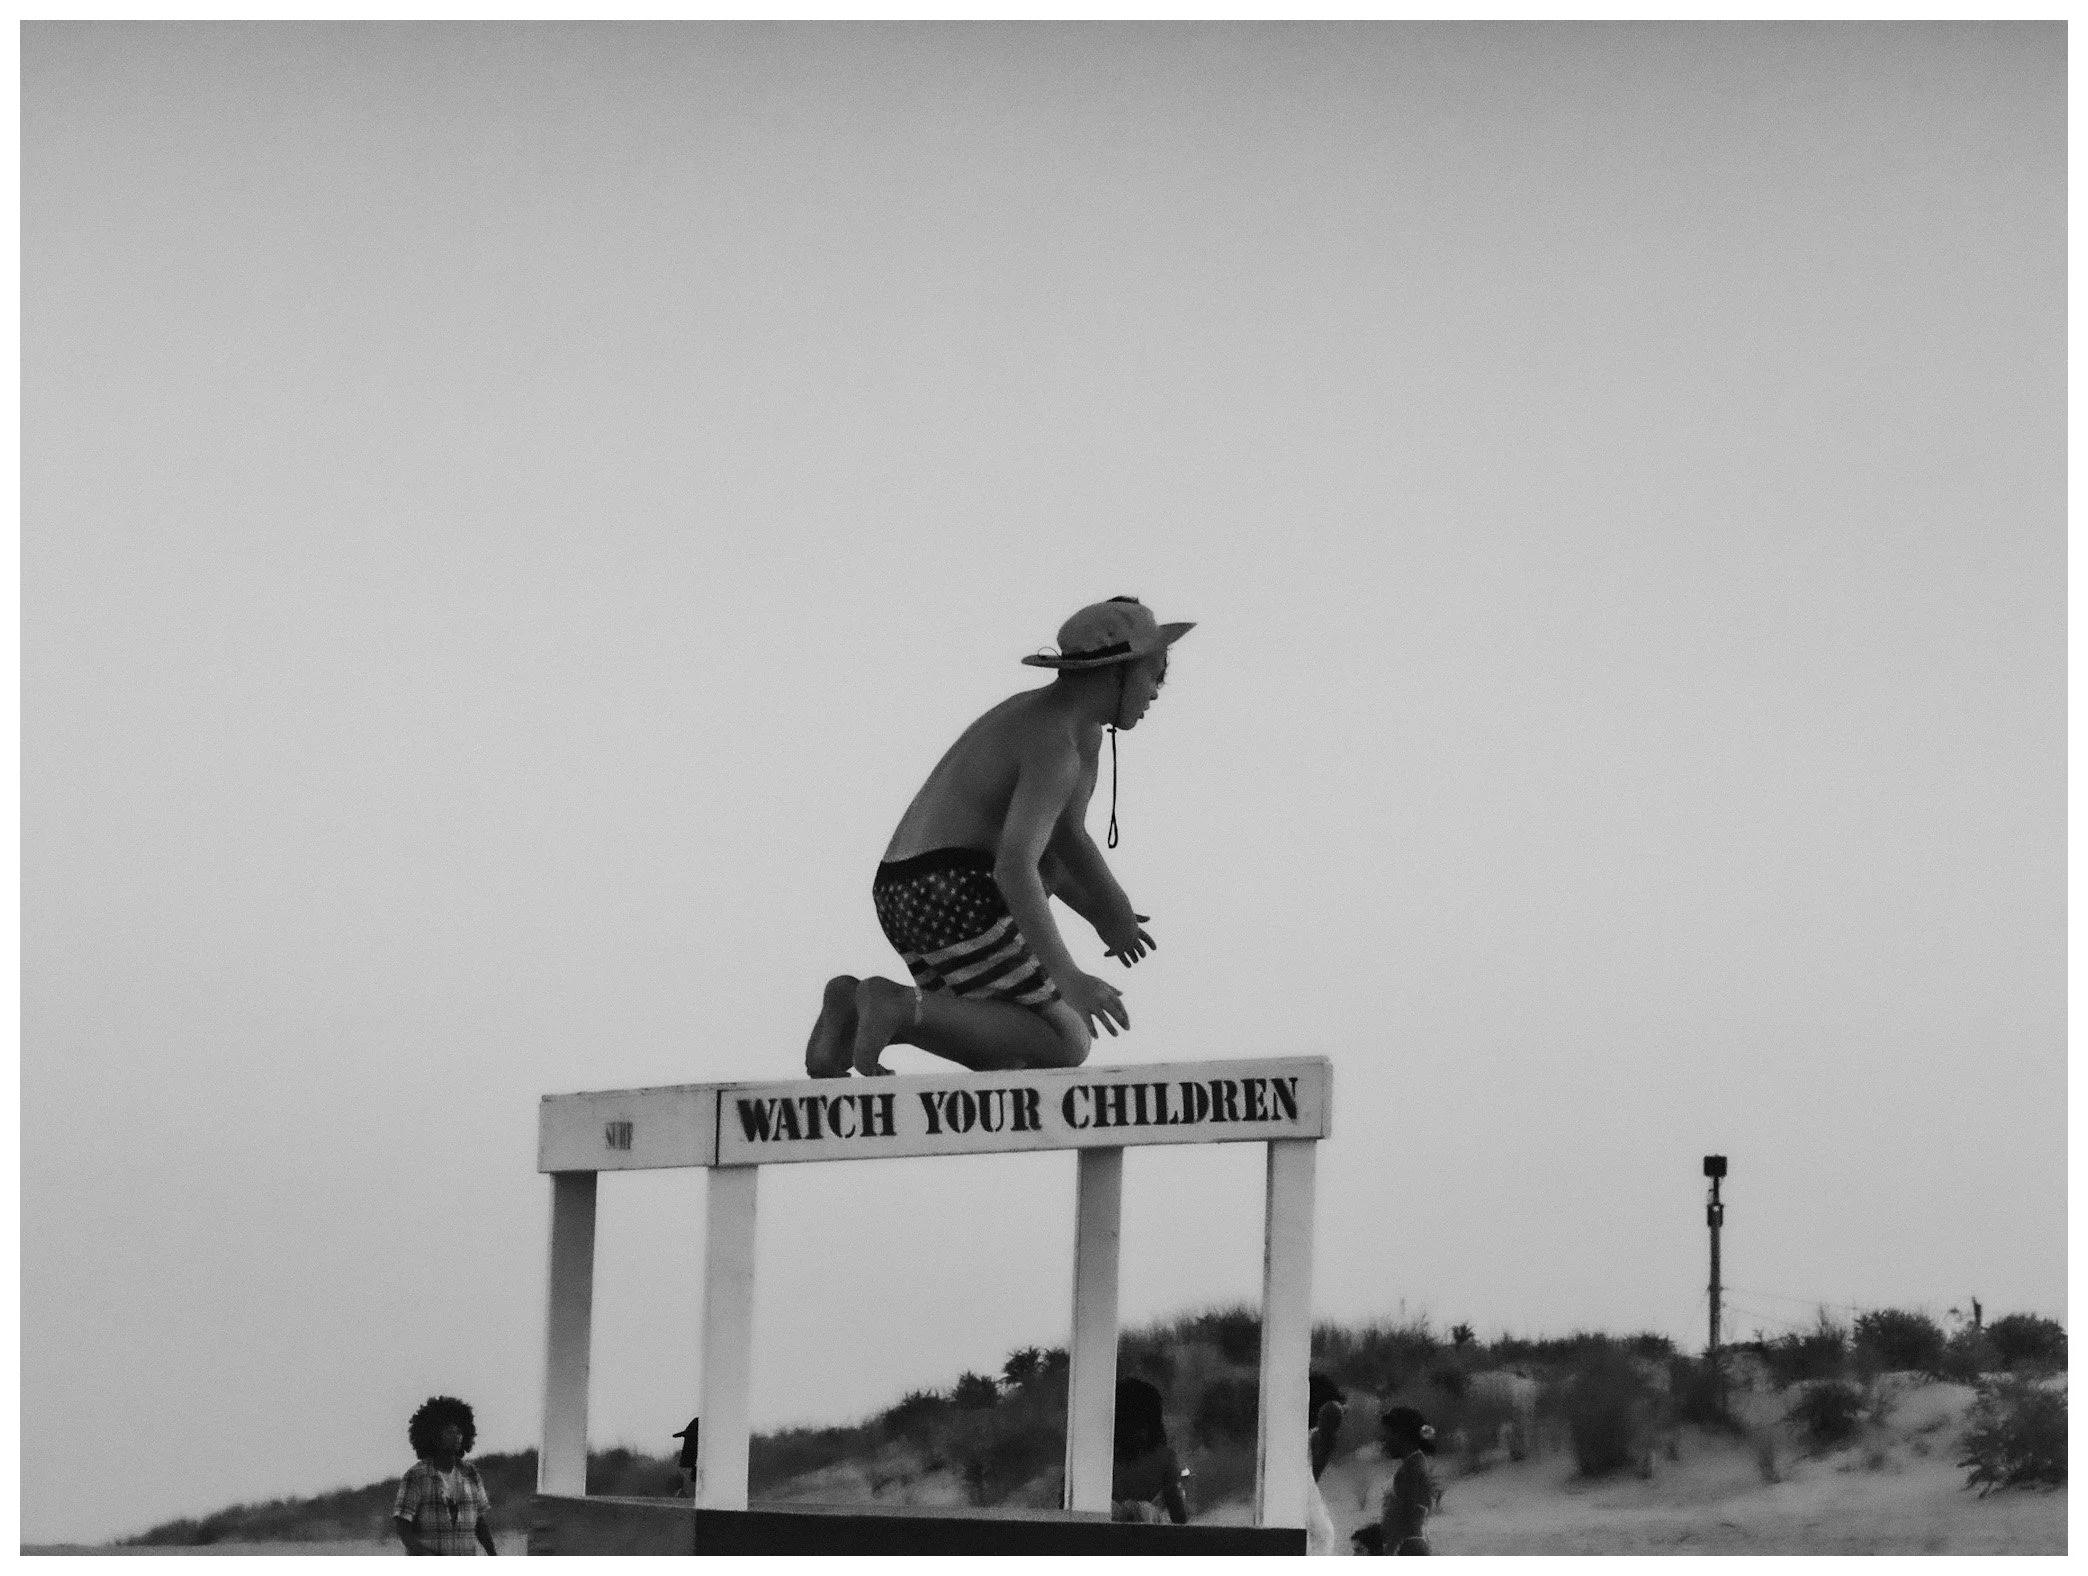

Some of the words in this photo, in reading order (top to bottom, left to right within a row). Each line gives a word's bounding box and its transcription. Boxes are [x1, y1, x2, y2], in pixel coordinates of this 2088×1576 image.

[736, 1093, 897, 1143] WATCH
[917, 1087, 1042, 1135] YOUR
[1061, 1077, 1299, 1129] CHILDREN
